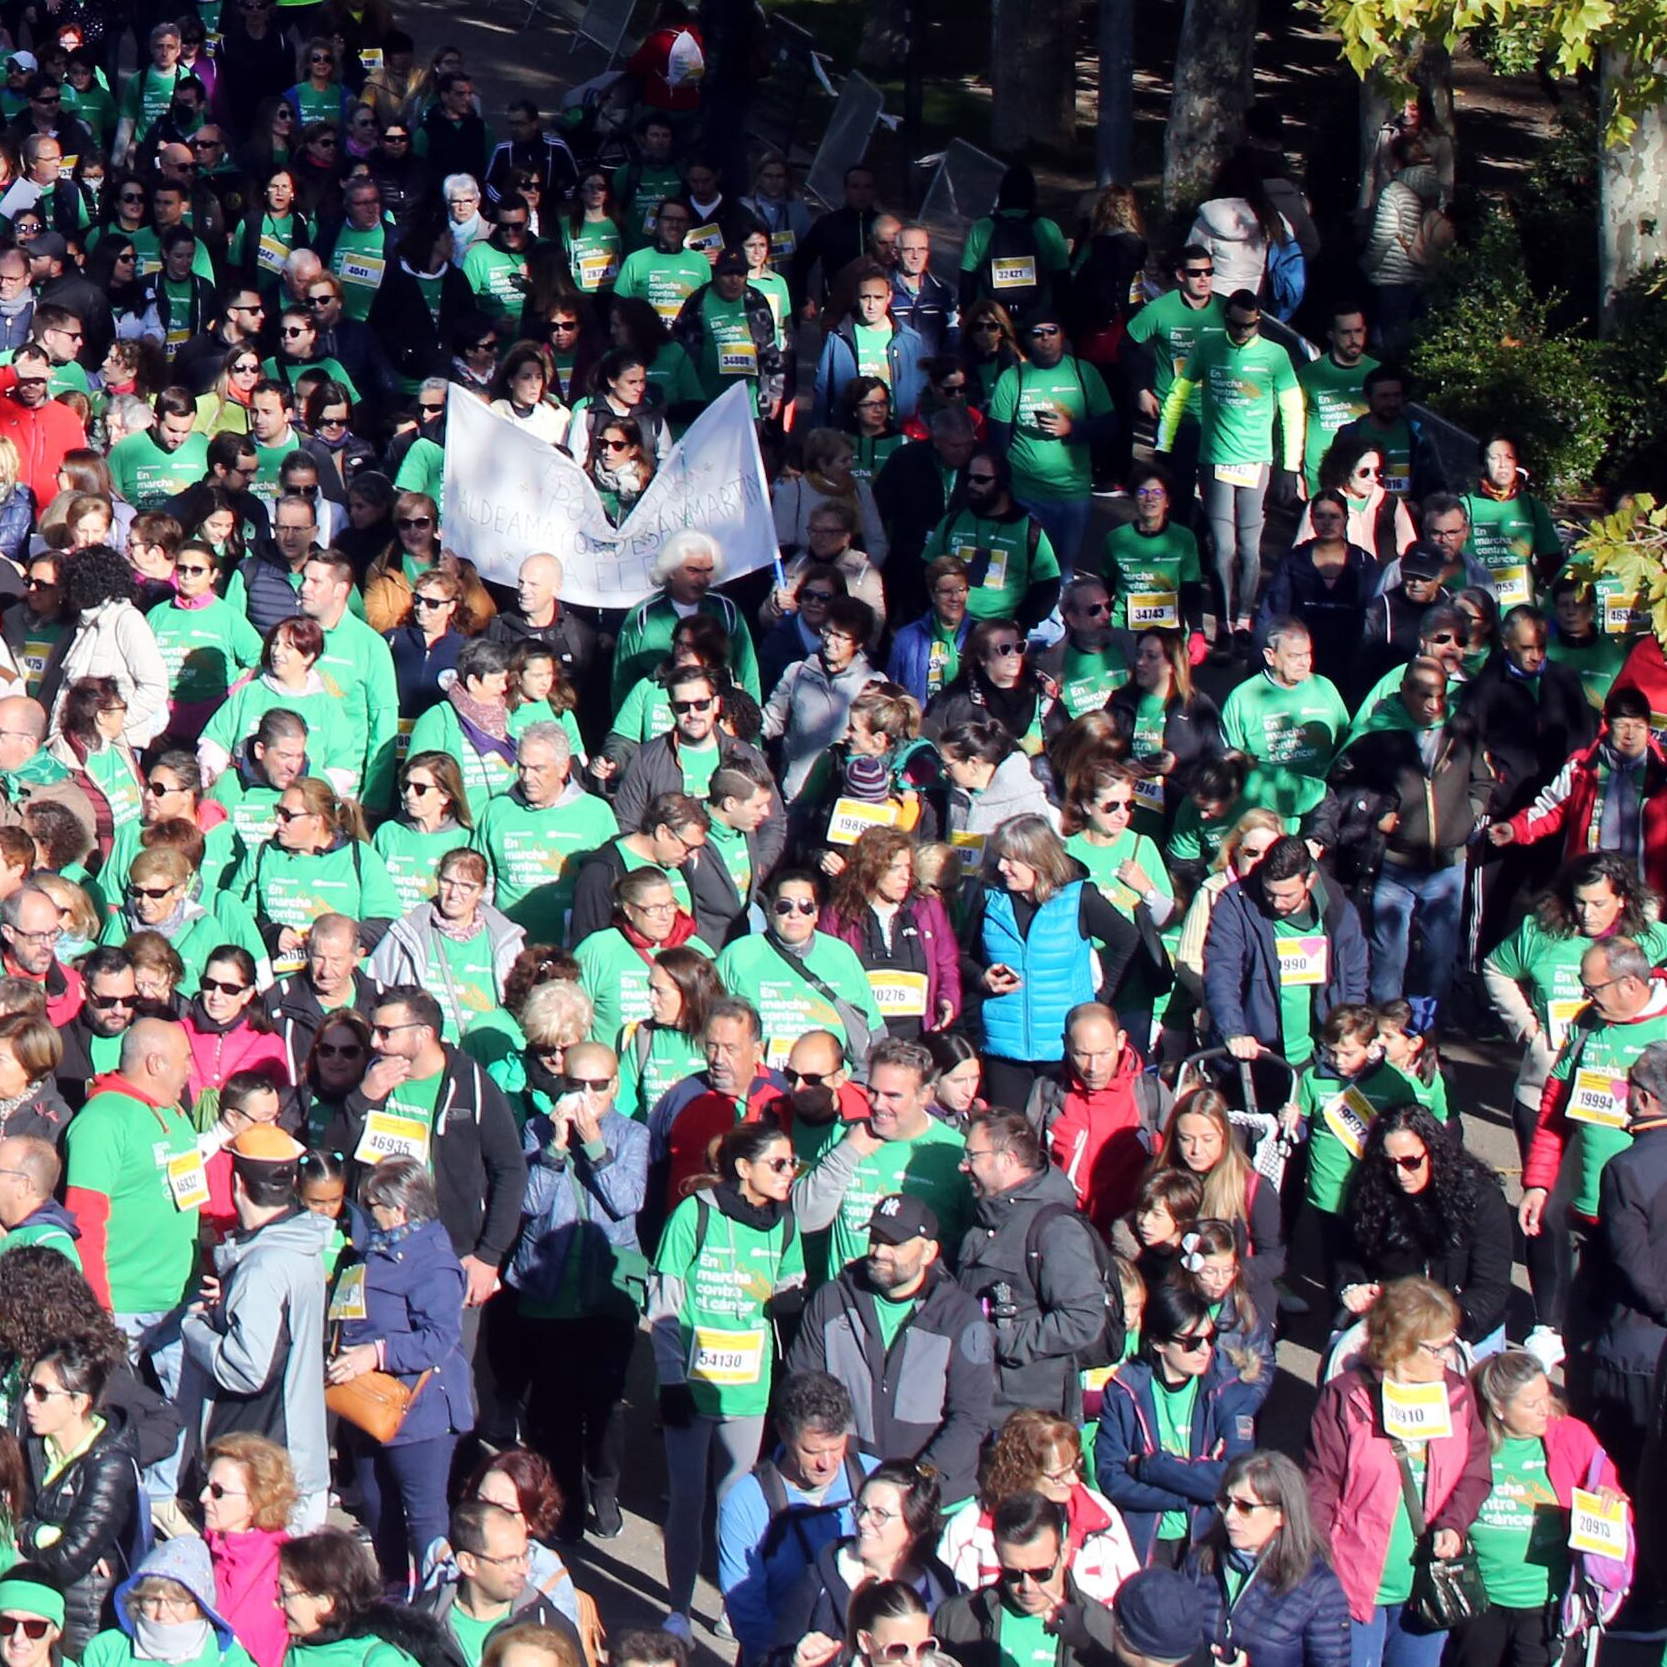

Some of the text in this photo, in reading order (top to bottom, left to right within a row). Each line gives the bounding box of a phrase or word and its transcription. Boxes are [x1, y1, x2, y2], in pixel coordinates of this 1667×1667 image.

[1318, 396, 1330, 404] En
[1319, 402, 1352, 412] marcha
[137, 471, 150, 480] En
[137, 480, 173, 490] marcha
[1474, 527, 1486, 537] En
[1474, 537, 1512, 547] marcha
[1135, 608, 1164, 621] 34743
[1071, 686, 1085, 696] En
[1263, 715, 1279, 730] En
[1265, 727, 1307, 741] marcha
[1268, 739, 1302, 752] contra
[840, 819, 867, 832] 1986
[504, 837, 518, 849] En
[504, 850, 548, 861] marcha
[506, 862, 543, 873] contra
[268, 884, 283, 896] En
[268, 896, 312, 908] marcha
[761, 987, 775, 999] En
[761, 999, 811, 1012] marcha
[761, 1011, 805, 1023] contra
[1580, 1091, 1614, 1111] 19994
[370, 1134, 411, 1155] 46935
[699, 1253, 718, 1268] En
[697, 1268, 753, 1285] marcha
[696, 1282, 743, 1298] contra
[695, 1297, 758, 1312] el cáncer
[699, 1352, 743, 1368] 54130
